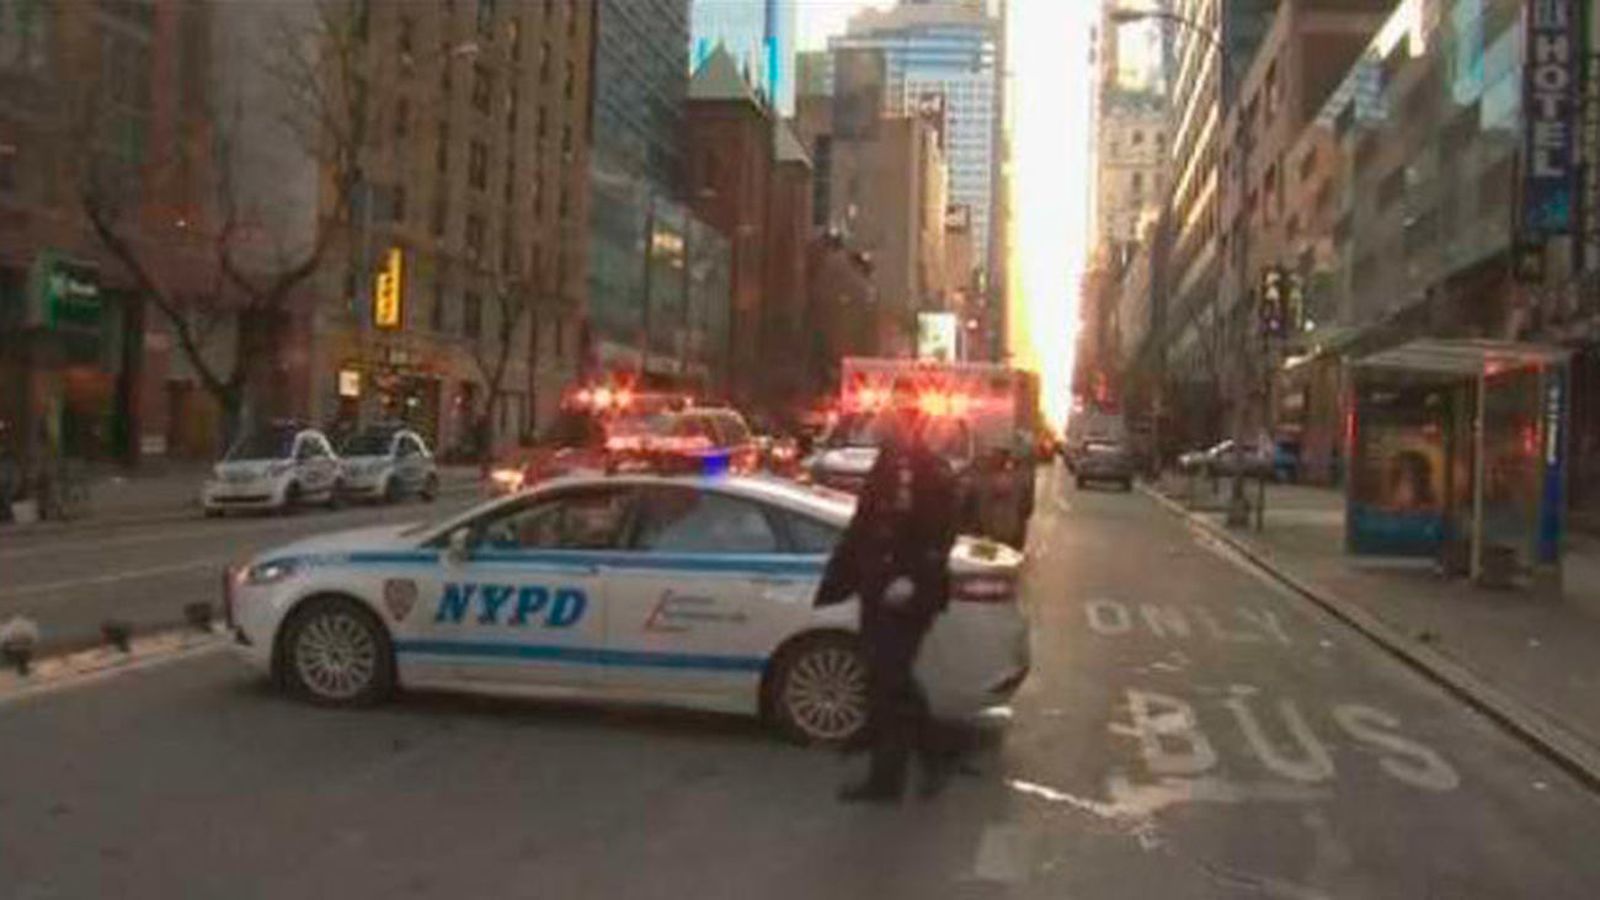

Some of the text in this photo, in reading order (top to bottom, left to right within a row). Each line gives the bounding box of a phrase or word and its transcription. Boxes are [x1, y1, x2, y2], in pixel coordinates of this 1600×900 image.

[1533, 34, 1569, 178] HOTEL
[434, 582, 589, 628] NYPD
[1084, 600, 1294, 644] ONLY
[1112, 688, 1460, 792] BUS
